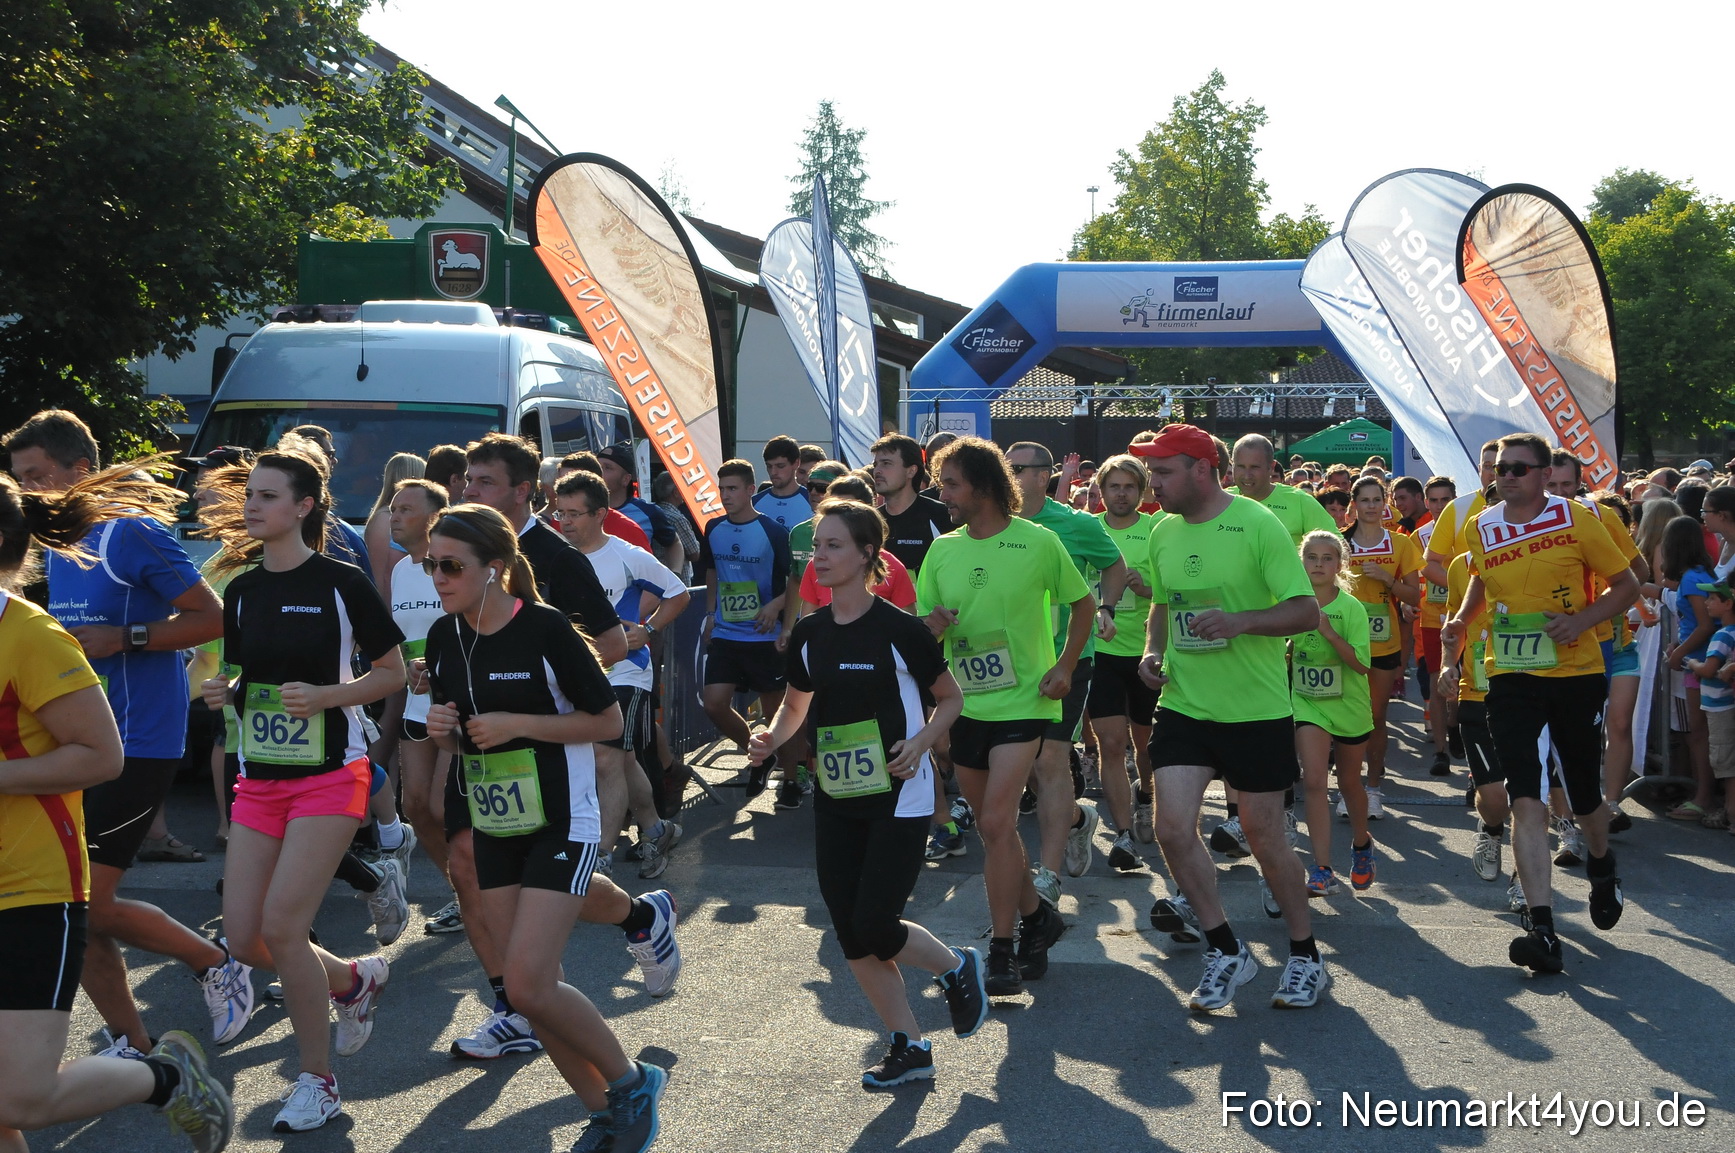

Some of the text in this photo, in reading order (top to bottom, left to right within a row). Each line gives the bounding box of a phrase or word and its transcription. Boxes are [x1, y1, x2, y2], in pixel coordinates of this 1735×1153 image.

[446, 283, 472, 293] 1628
[1158, 302, 1257, 321] firmenlauf
[972, 336, 1024, 347] Fischer
[1006, 542, 1027, 550] DEKRA
[1484, 533, 1578, 570] MAX BÖGL
[287, 605, 322, 614] PFLEIDERER
[392, 600, 441, 612] DELPHI
[721, 594, 759, 612] 1223
[1498, 632, 1543, 656] 777
[494, 672, 531, 680] PFLEIDERER
[844, 663, 875, 671] PFLEIDERER
[958, 653, 1004, 681] 198
[1297, 665, 1334, 688] 190
[252, 711, 310, 745] 962
[823, 748, 875, 781] 975
[472, 781, 526, 817] 961
